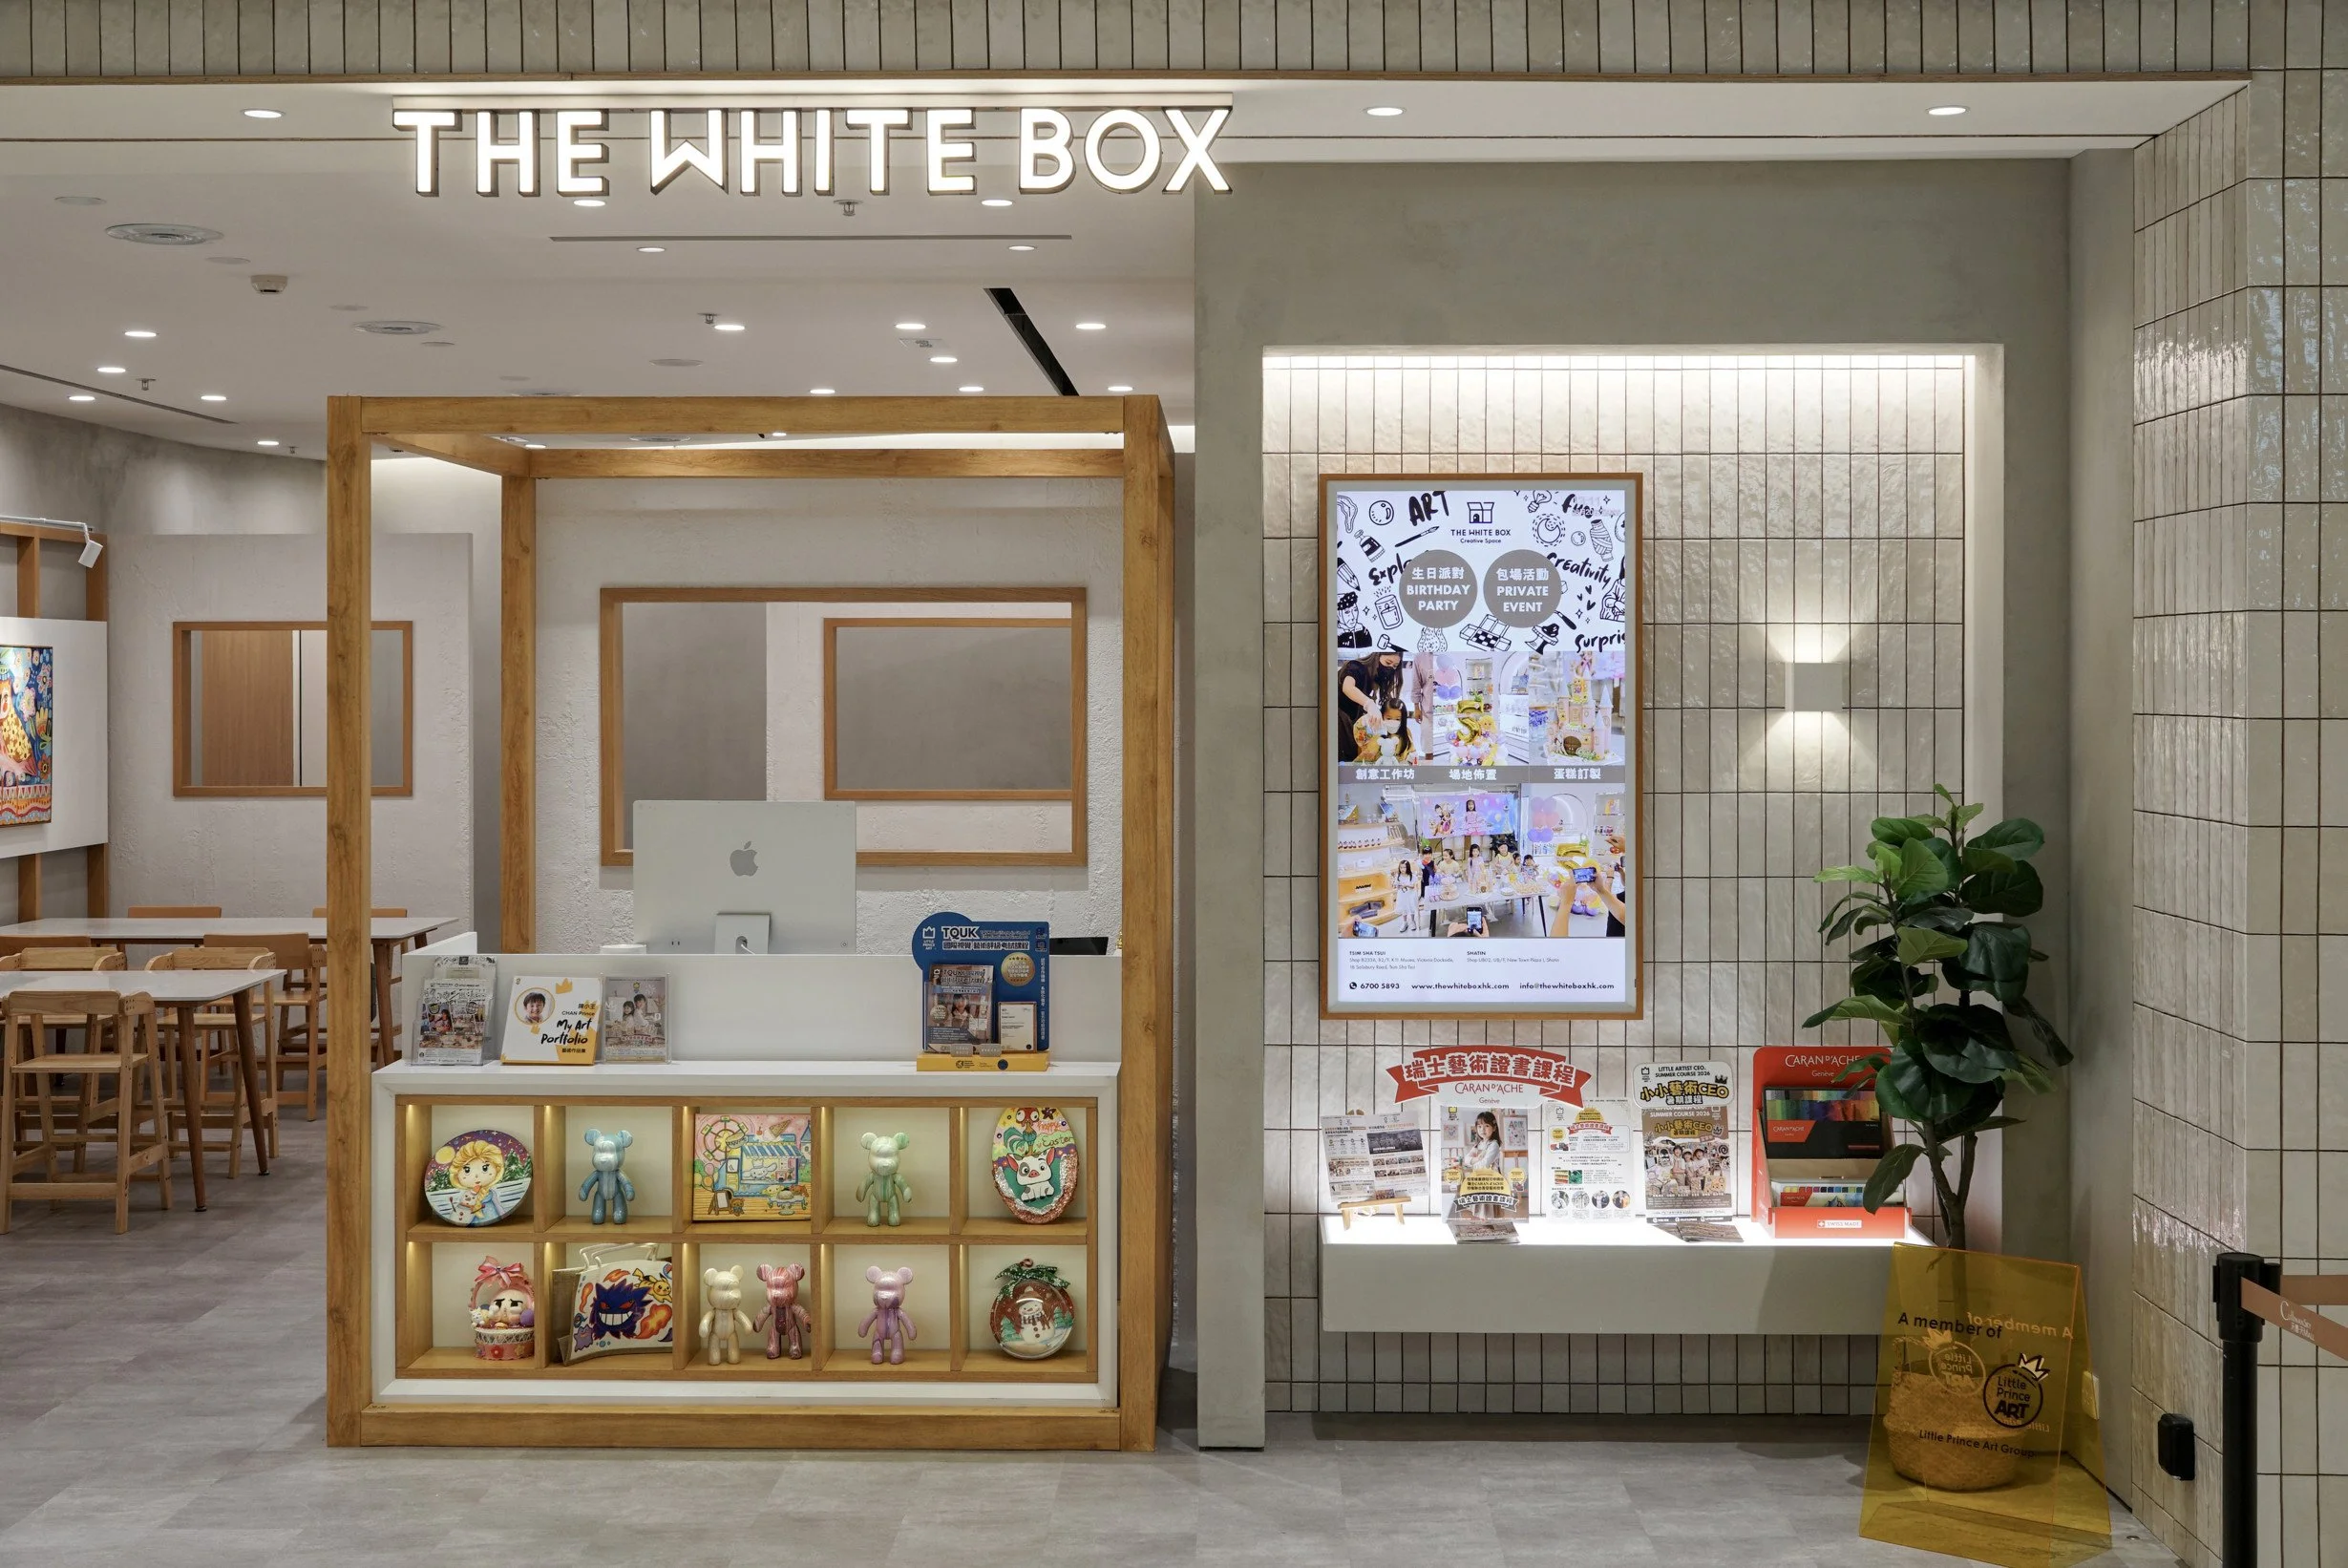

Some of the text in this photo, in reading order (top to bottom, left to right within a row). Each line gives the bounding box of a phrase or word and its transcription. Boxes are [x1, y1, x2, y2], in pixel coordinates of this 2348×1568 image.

[392, 108, 1234, 198] THE WHITE BOX
[1408, 491, 1449, 526] ART
[1411, 566, 1465, 580] 生日派對
[1495, 567, 1549, 582] 包場活動
[1407, 584, 1470, 596] BIRTHDAY
[1496, 585, 1549, 597] PRIVATE
[1418, 600, 1459, 611] PARTY
[1503, 602, 1543, 613] EVENT
[1355, 768, 1415, 780] 創意工作坊
[1554, 768, 1601, 780] 蛋糕訂製
[941, 927, 979, 940] TQUK
[557, 1017, 592, 1033] My Art
[540, 1031, 588, 1045] Portfolio
[1785, 1054, 1824, 1068] CARAN
[1404, 1052, 1576, 1086] 瑞士藝術證書課程
[1454, 1082, 1490, 1094] CARAN
[1640, 1079, 1729, 1101] 小小藝術CEO
[1655, 1119, 1713, 1134] 小小藝術CEO
[1042, 1134, 1074, 1147] Easter
[1897, 1312, 2003, 1339] A member of
[1998, 1376, 2027, 1390] Little
[1996, 1387, 2031, 1402] Prince
[1994, 1400, 2031, 1419] ART
[1919, 1429, 1944, 1443] Little
[1946, 1434, 1980, 1450] Prince
[1982, 1440, 1999, 1451] Art
